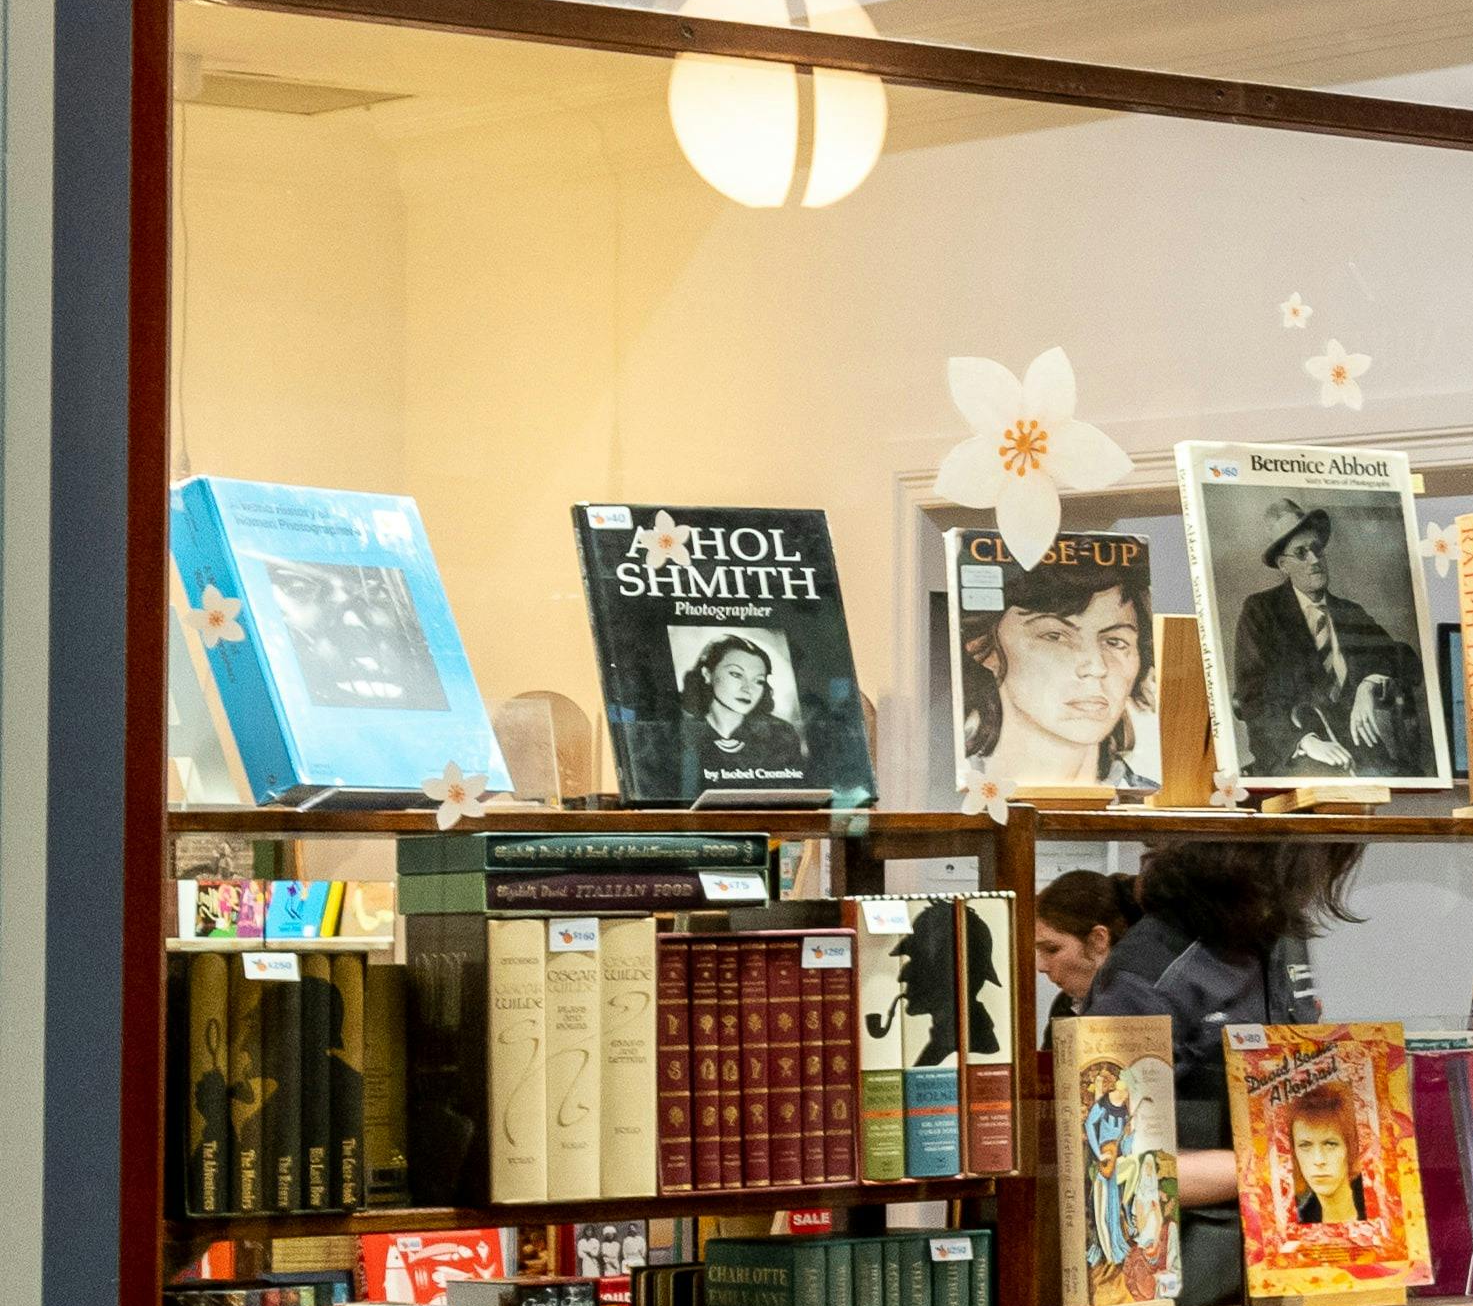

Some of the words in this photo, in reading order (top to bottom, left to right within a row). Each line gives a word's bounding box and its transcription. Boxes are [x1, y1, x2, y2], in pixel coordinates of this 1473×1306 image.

[1250, 453, 1325, 475] Berenice
[1328, 455, 1390, 478] Abbott
[615, 562, 822, 601] SHMITH
[674, 601, 773, 621] Photographer
[703, 769, 719, 781] by
[720, 768, 754, 780] Isobel
[755, 768, 804, 781] Crombie
[702, 844, 738, 859] FOOD
[576, 884, 647, 899] ITALIAN
[653, 883, 693, 898] FOOD
[603, 968, 652, 982] WILDE
[495, 996, 543, 1010] WILDE
[792, 1211, 831, 1226] SALE
[707, 1265, 789, 1286] CHARLOTTE
